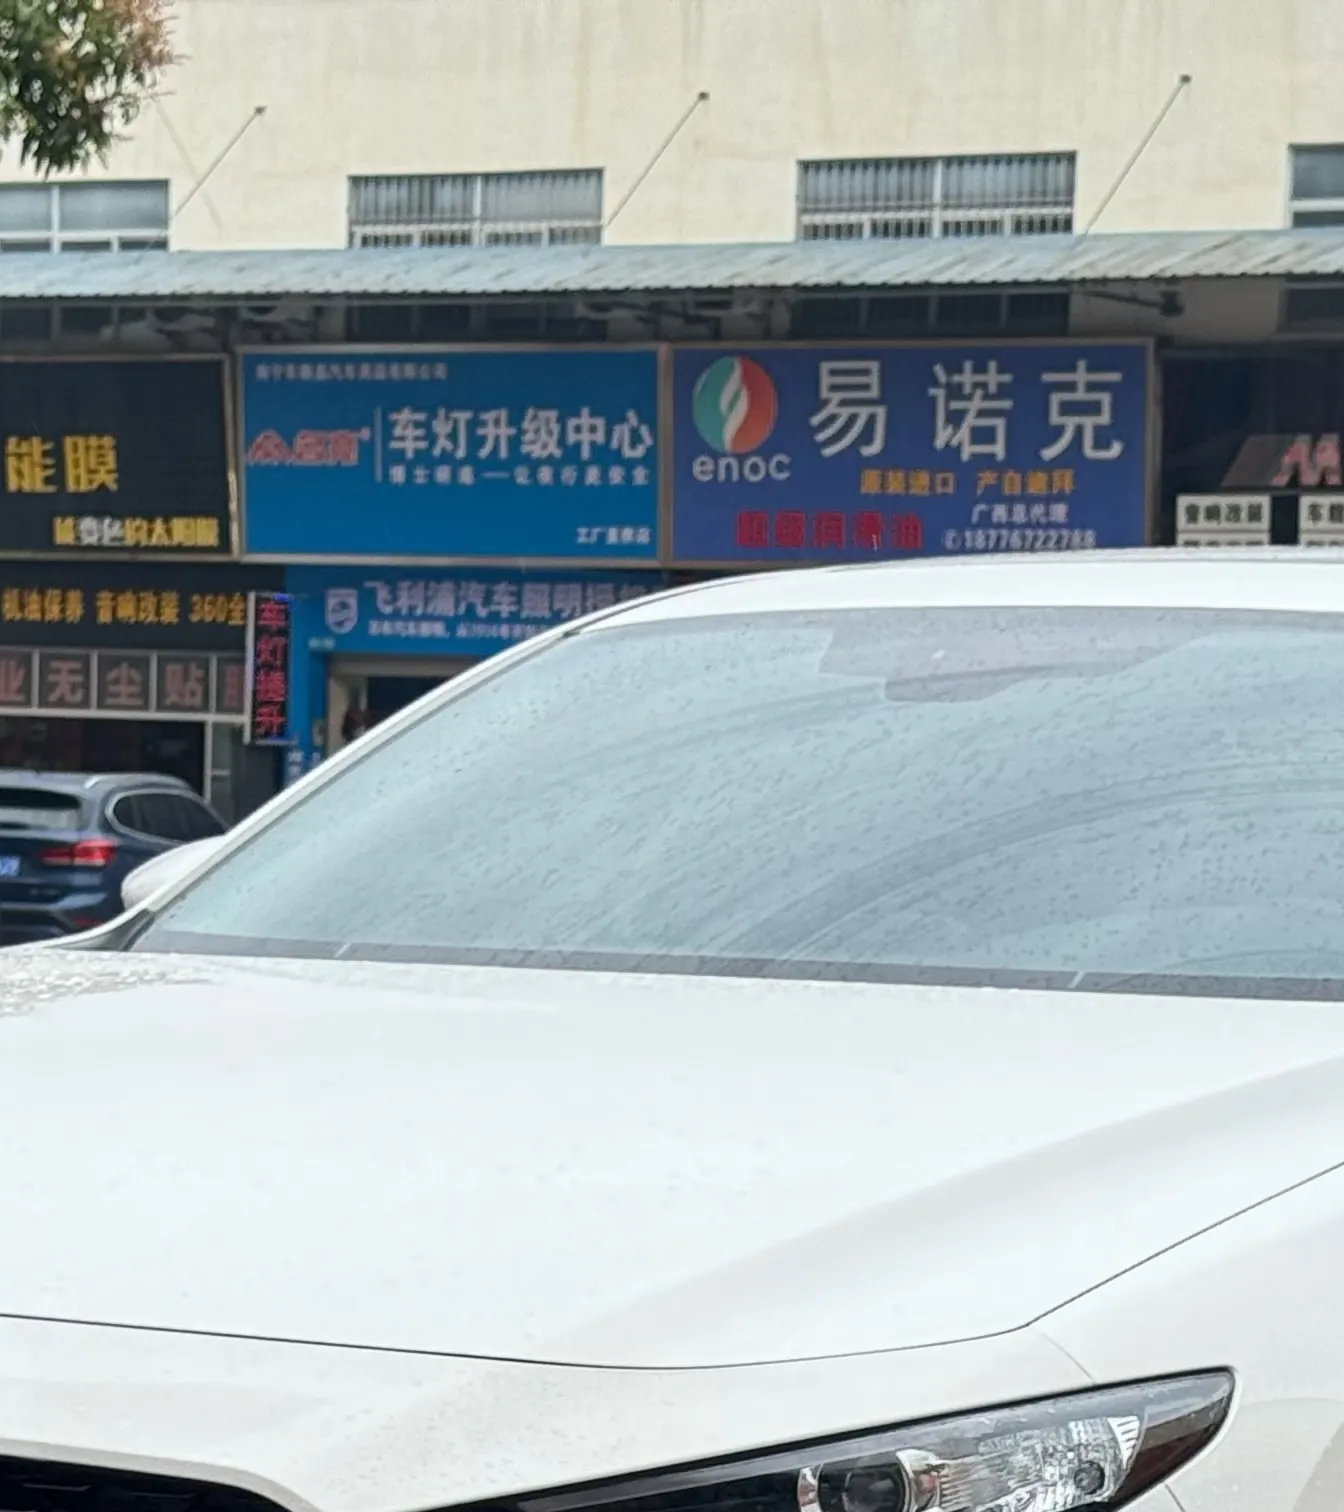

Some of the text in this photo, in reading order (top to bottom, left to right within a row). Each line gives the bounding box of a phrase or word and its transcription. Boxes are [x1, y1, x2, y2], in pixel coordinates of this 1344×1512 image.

[810, 359, 1125, 463] 易诺克
[388, 406, 654, 461] 车灯升级中心
[692, 454, 791, 483] enoc
[860, 469, 955, 496] 原装进口
